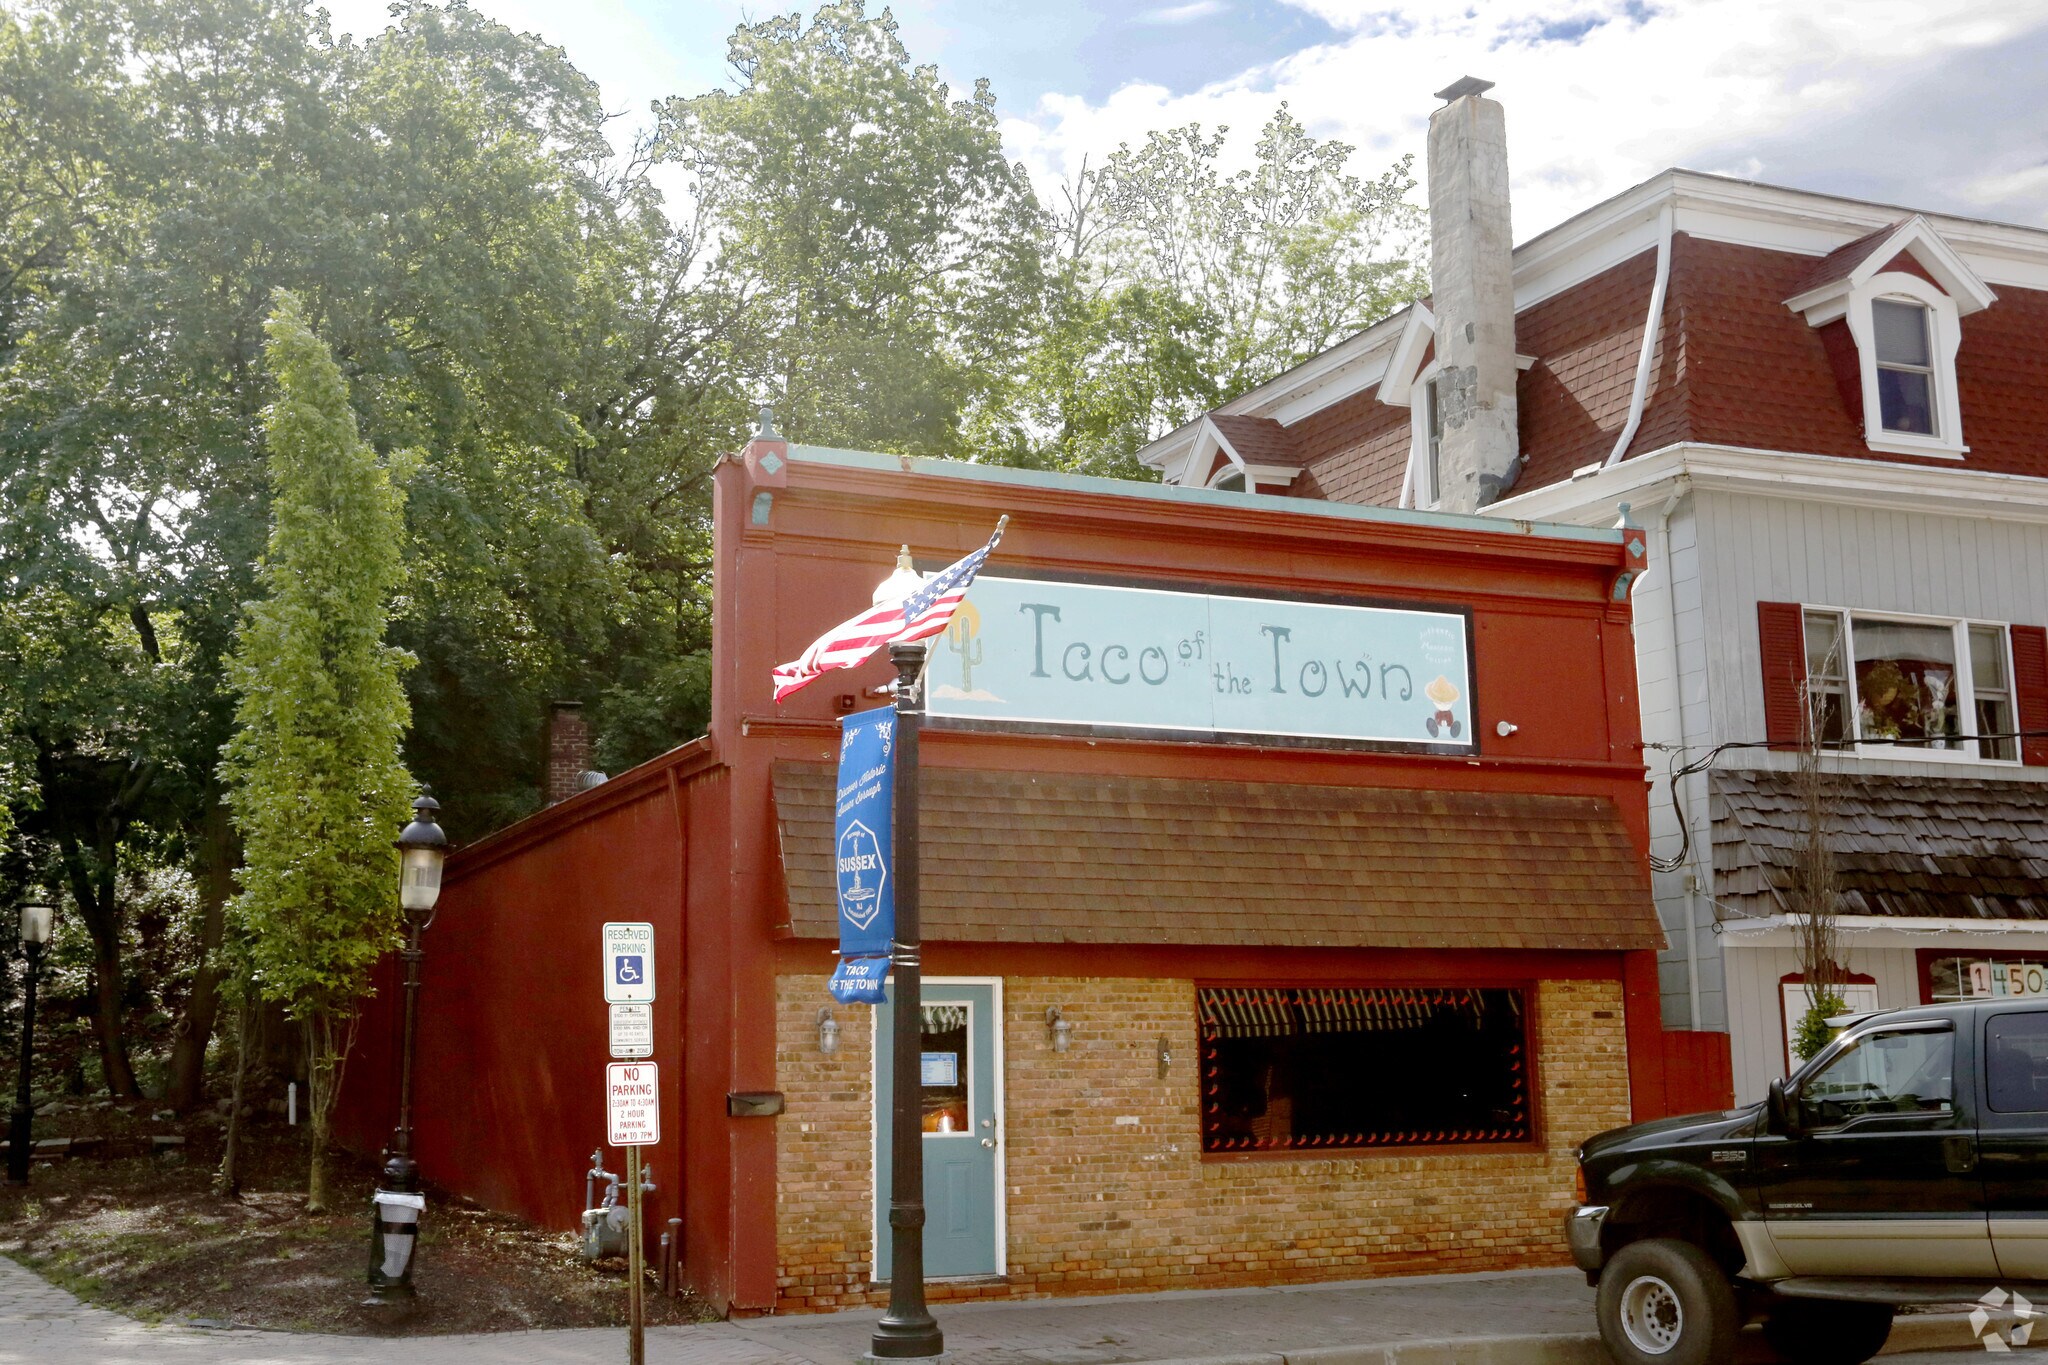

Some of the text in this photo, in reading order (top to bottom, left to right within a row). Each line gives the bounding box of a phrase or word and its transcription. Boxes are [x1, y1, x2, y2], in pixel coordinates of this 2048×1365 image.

[1019, 602, 1413, 701] Taco of the Town
[840, 854, 876, 873] SUSSEX
[608, 929, 650, 940] RESERVED
[612, 943, 646, 953] PARKING
[845, 965, 869, 976] TACO
[830, 978, 878, 991] OF THE TOWN
[623, 1067, 640, 1081] NO
[612, 1083, 652, 1096] PARKING
[630, 1099, 636, 1107] TO
[620, 1110, 645, 1118] 2 HOUR
[619, 1120, 646, 1129] PARKING
[613, 1131, 653, 1141] 8AM TO 7PM
